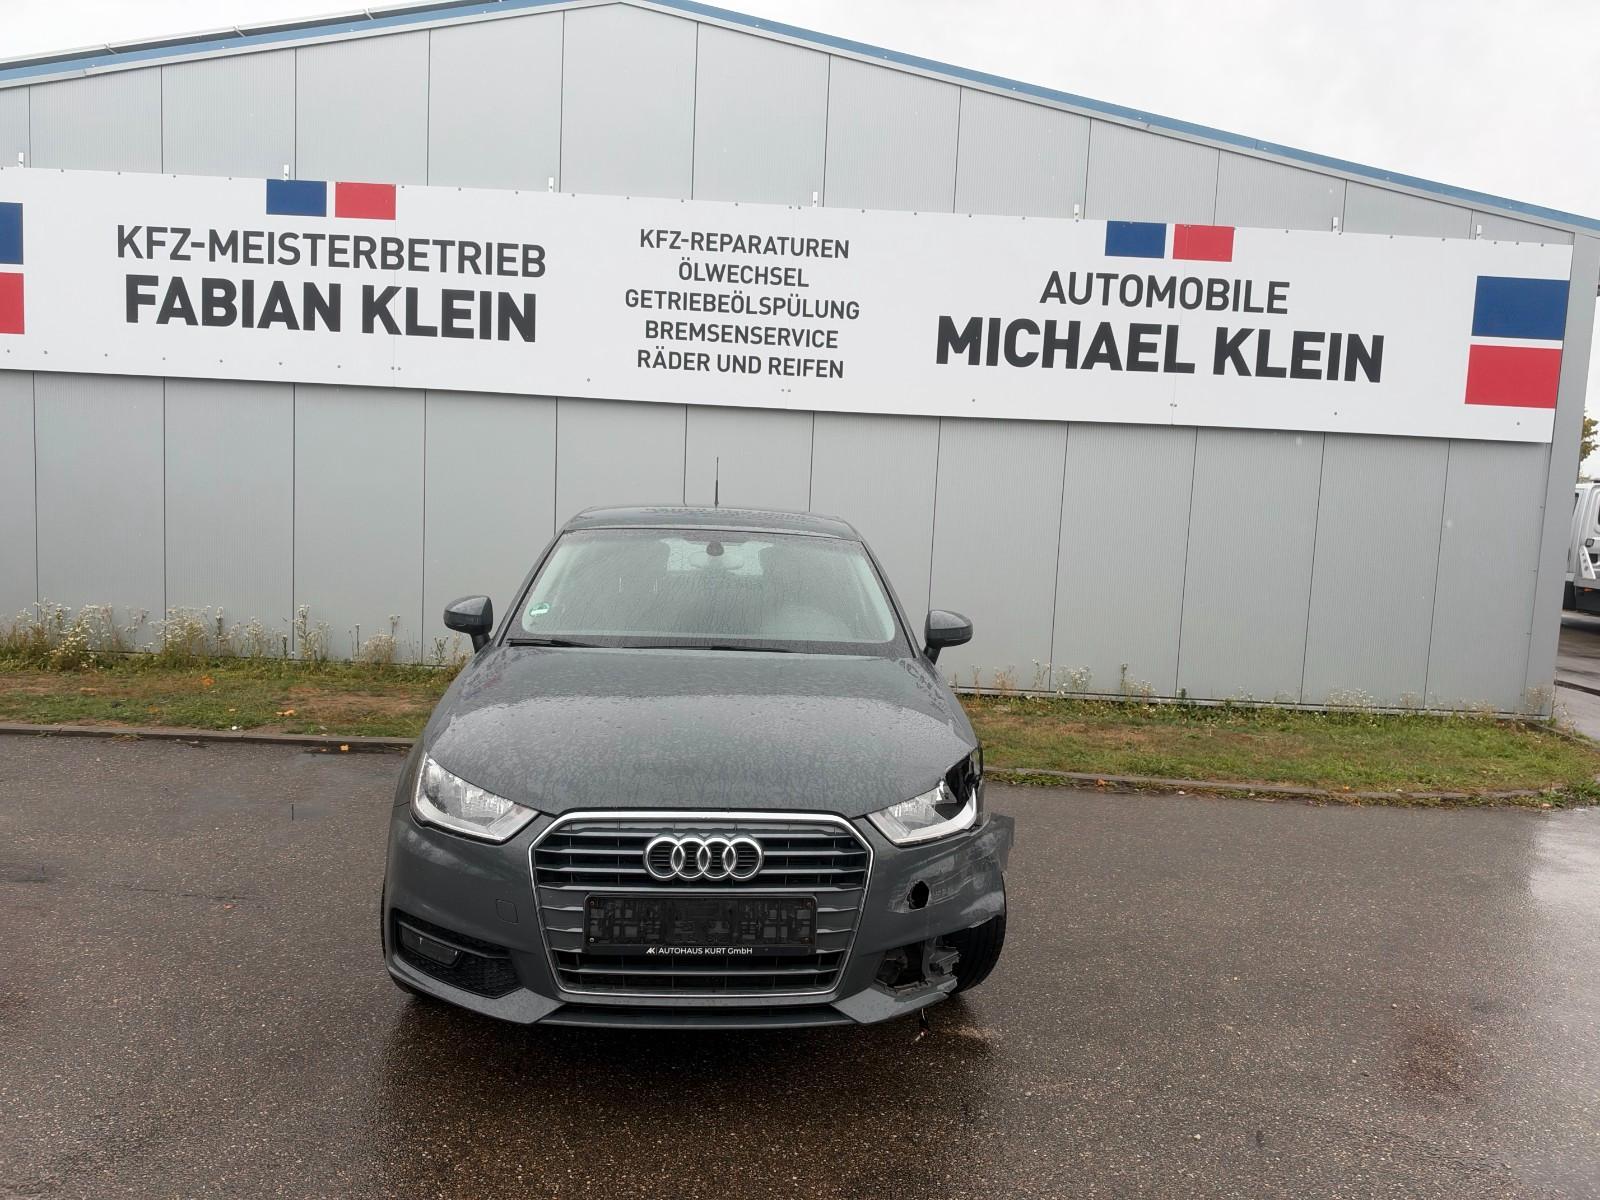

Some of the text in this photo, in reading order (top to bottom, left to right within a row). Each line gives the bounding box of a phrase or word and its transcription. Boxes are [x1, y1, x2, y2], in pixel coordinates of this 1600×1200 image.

[118, 225, 545, 277] KFZ-MEISTERBETRIEB
[641, 229, 849, 258] KFZ-REPARATUREN
[679, 257, 809, 287] ÖLWECHSEL
[626, 289, 859, 319] GETRIEBEÖLSPÜLUNG
[1040, 271, 1289, 314] AUTOMOBILE
[126, 275, 536, 342] FABIAN KLEIN
[646, 320, 838, 348] BREMSENSERVICE
[936, 316, 1384, 383] MICHAEL KLEIN
[638, 346, 843, 378] RÄDER UND REIFEN
[658, 947, 703, 955] AUTOHAUS
[704, 947, 726, 955] KURT
[727, 947, 753, 955] GmbH
